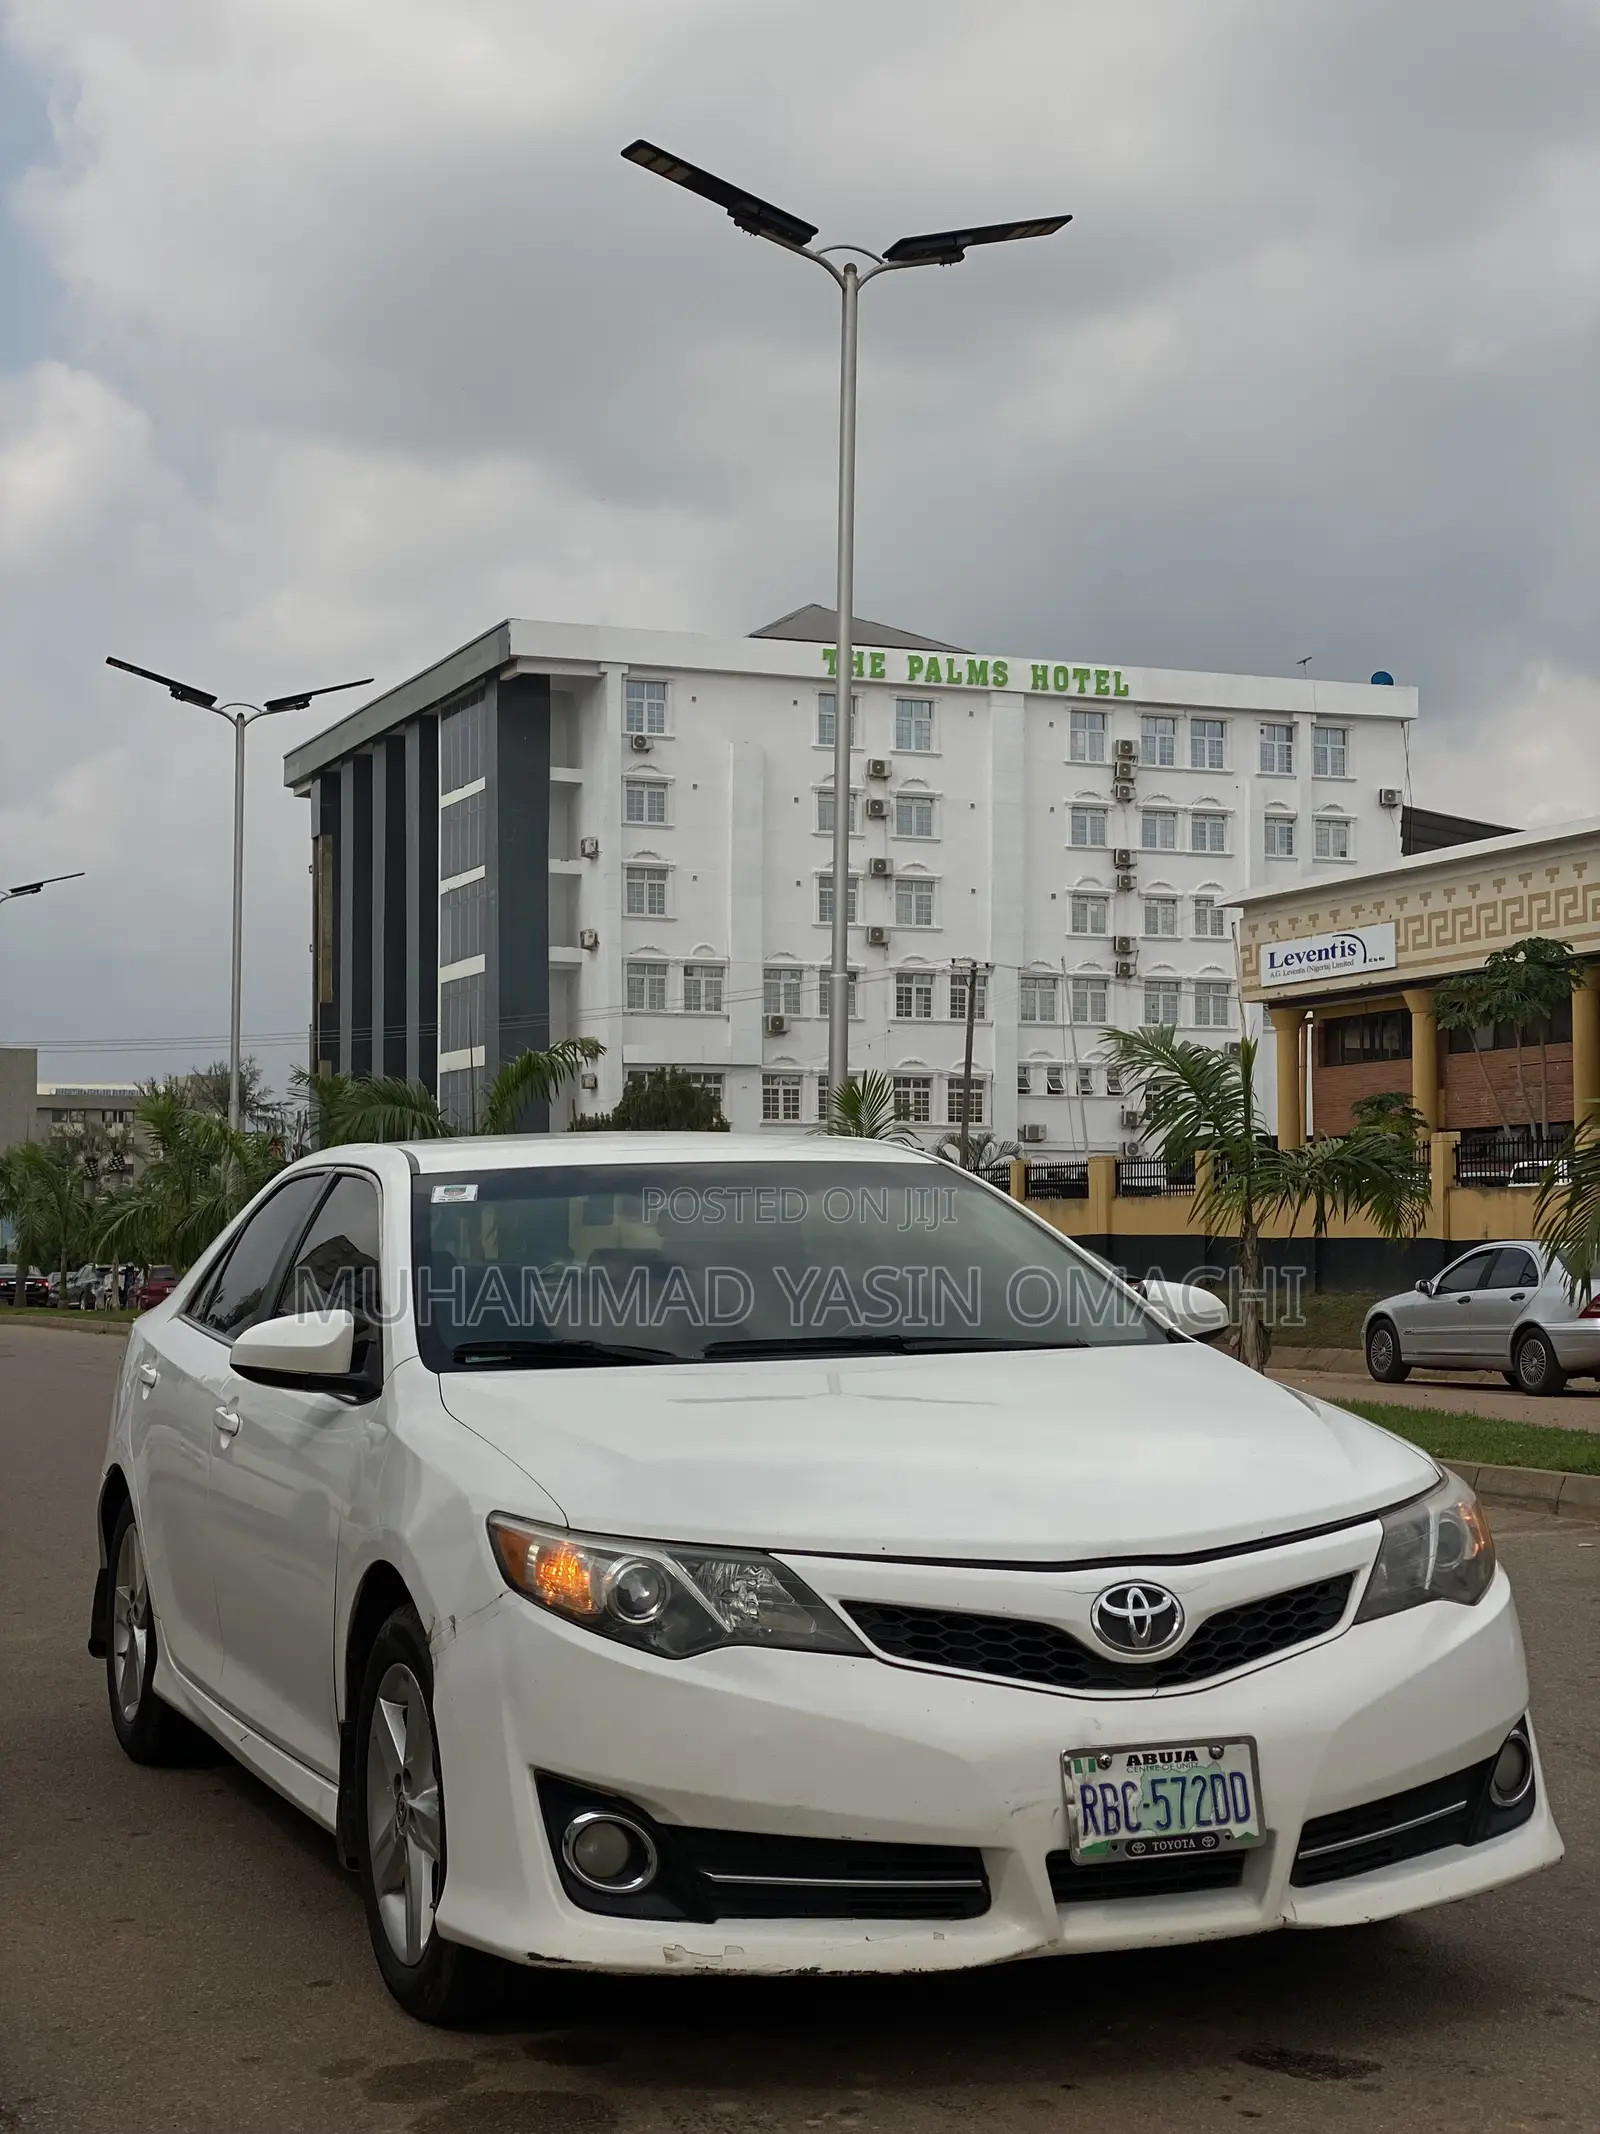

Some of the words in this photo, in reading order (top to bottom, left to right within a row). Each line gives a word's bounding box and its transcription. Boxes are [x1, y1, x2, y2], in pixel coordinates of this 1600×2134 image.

[823, 648, 885, 678] THE
[907, 655, 1008, 687] PALMS
[1031, 664, 1129, 697] HOTEL
[1268, 940, 1357, 970] Leventis
[1283, 968, 1306, 976] Leventis
[1332, 959, 1354, 969] Limited
[1126, 1750, 1198, 1766] ABUJA
[1126, 1765, 1160, 1774] CENTRE
[1162, 1763, 1175, 1771] OF
[1176, 1761, 1199, 1769] UNITY
[1080, 1772, 1251, 1836] RBC-572DD
[1152, 1839, 1197, 1851] TOYOTA
